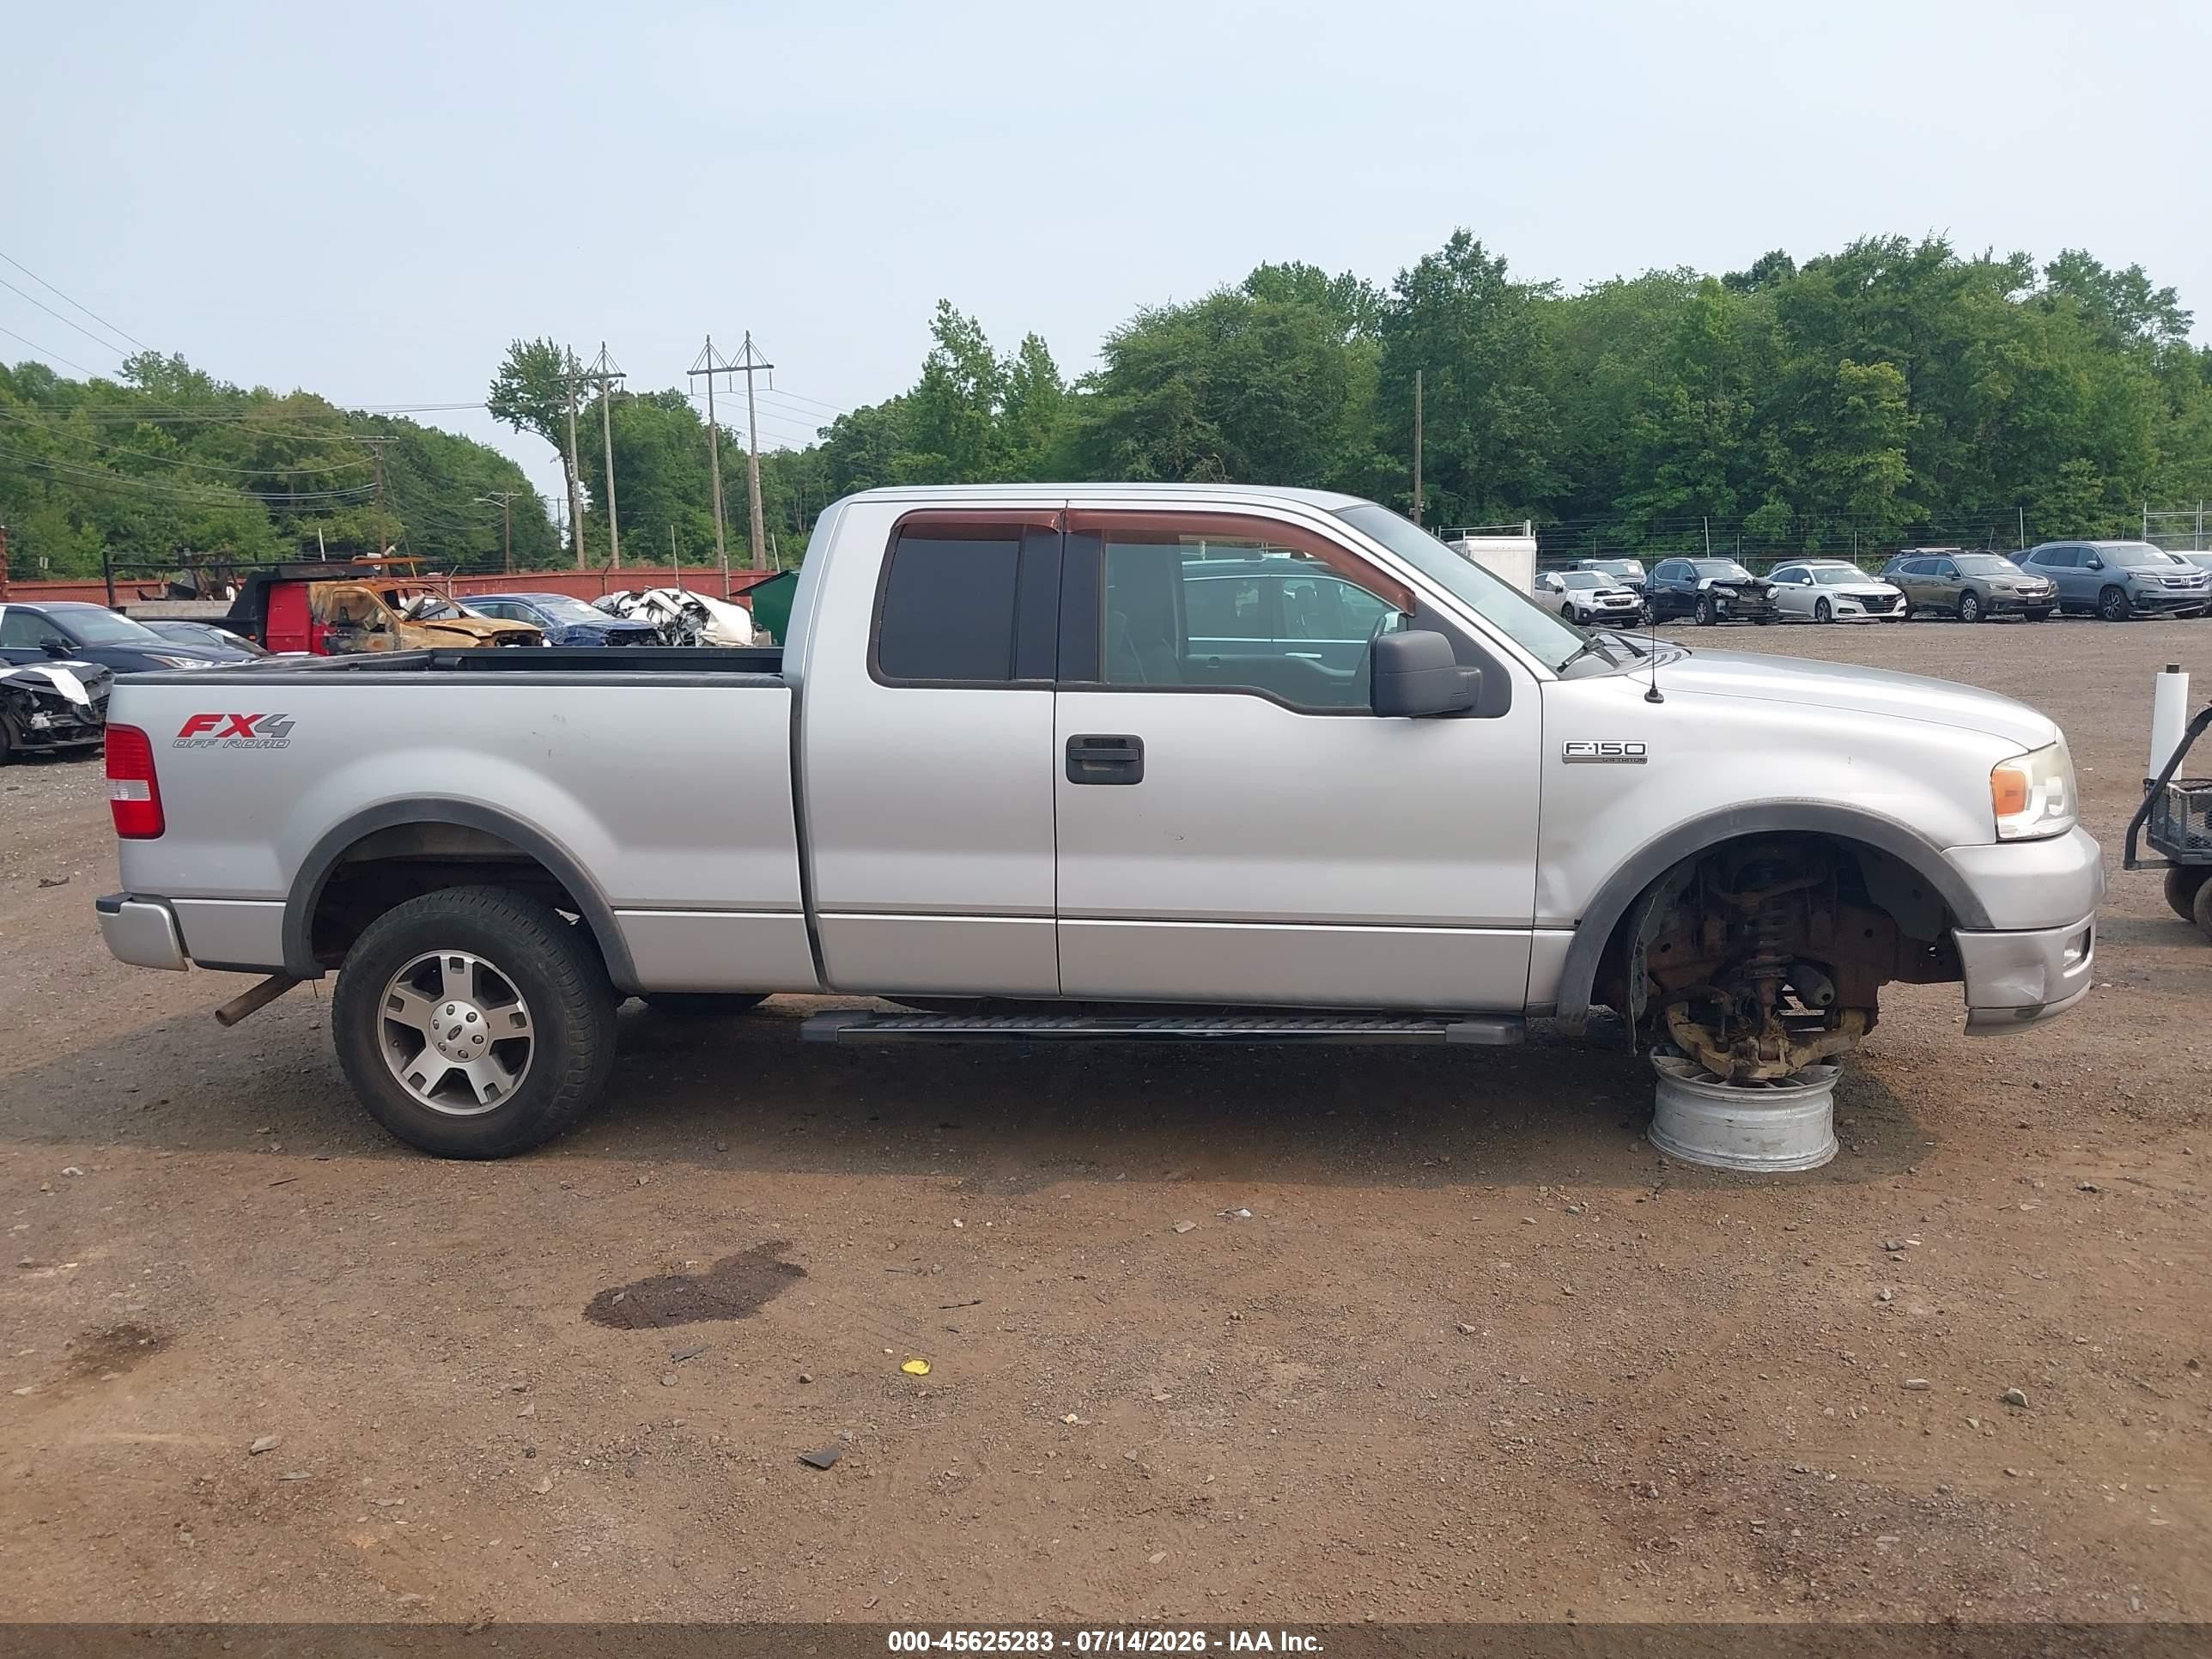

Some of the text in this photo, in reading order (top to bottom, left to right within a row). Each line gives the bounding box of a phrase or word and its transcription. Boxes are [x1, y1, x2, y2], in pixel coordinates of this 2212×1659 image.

[176, 714, 296, 738] FX4
[173, 738, 290, 749] OFF ROAD
[1565, 742, 1646, 756] F-150
